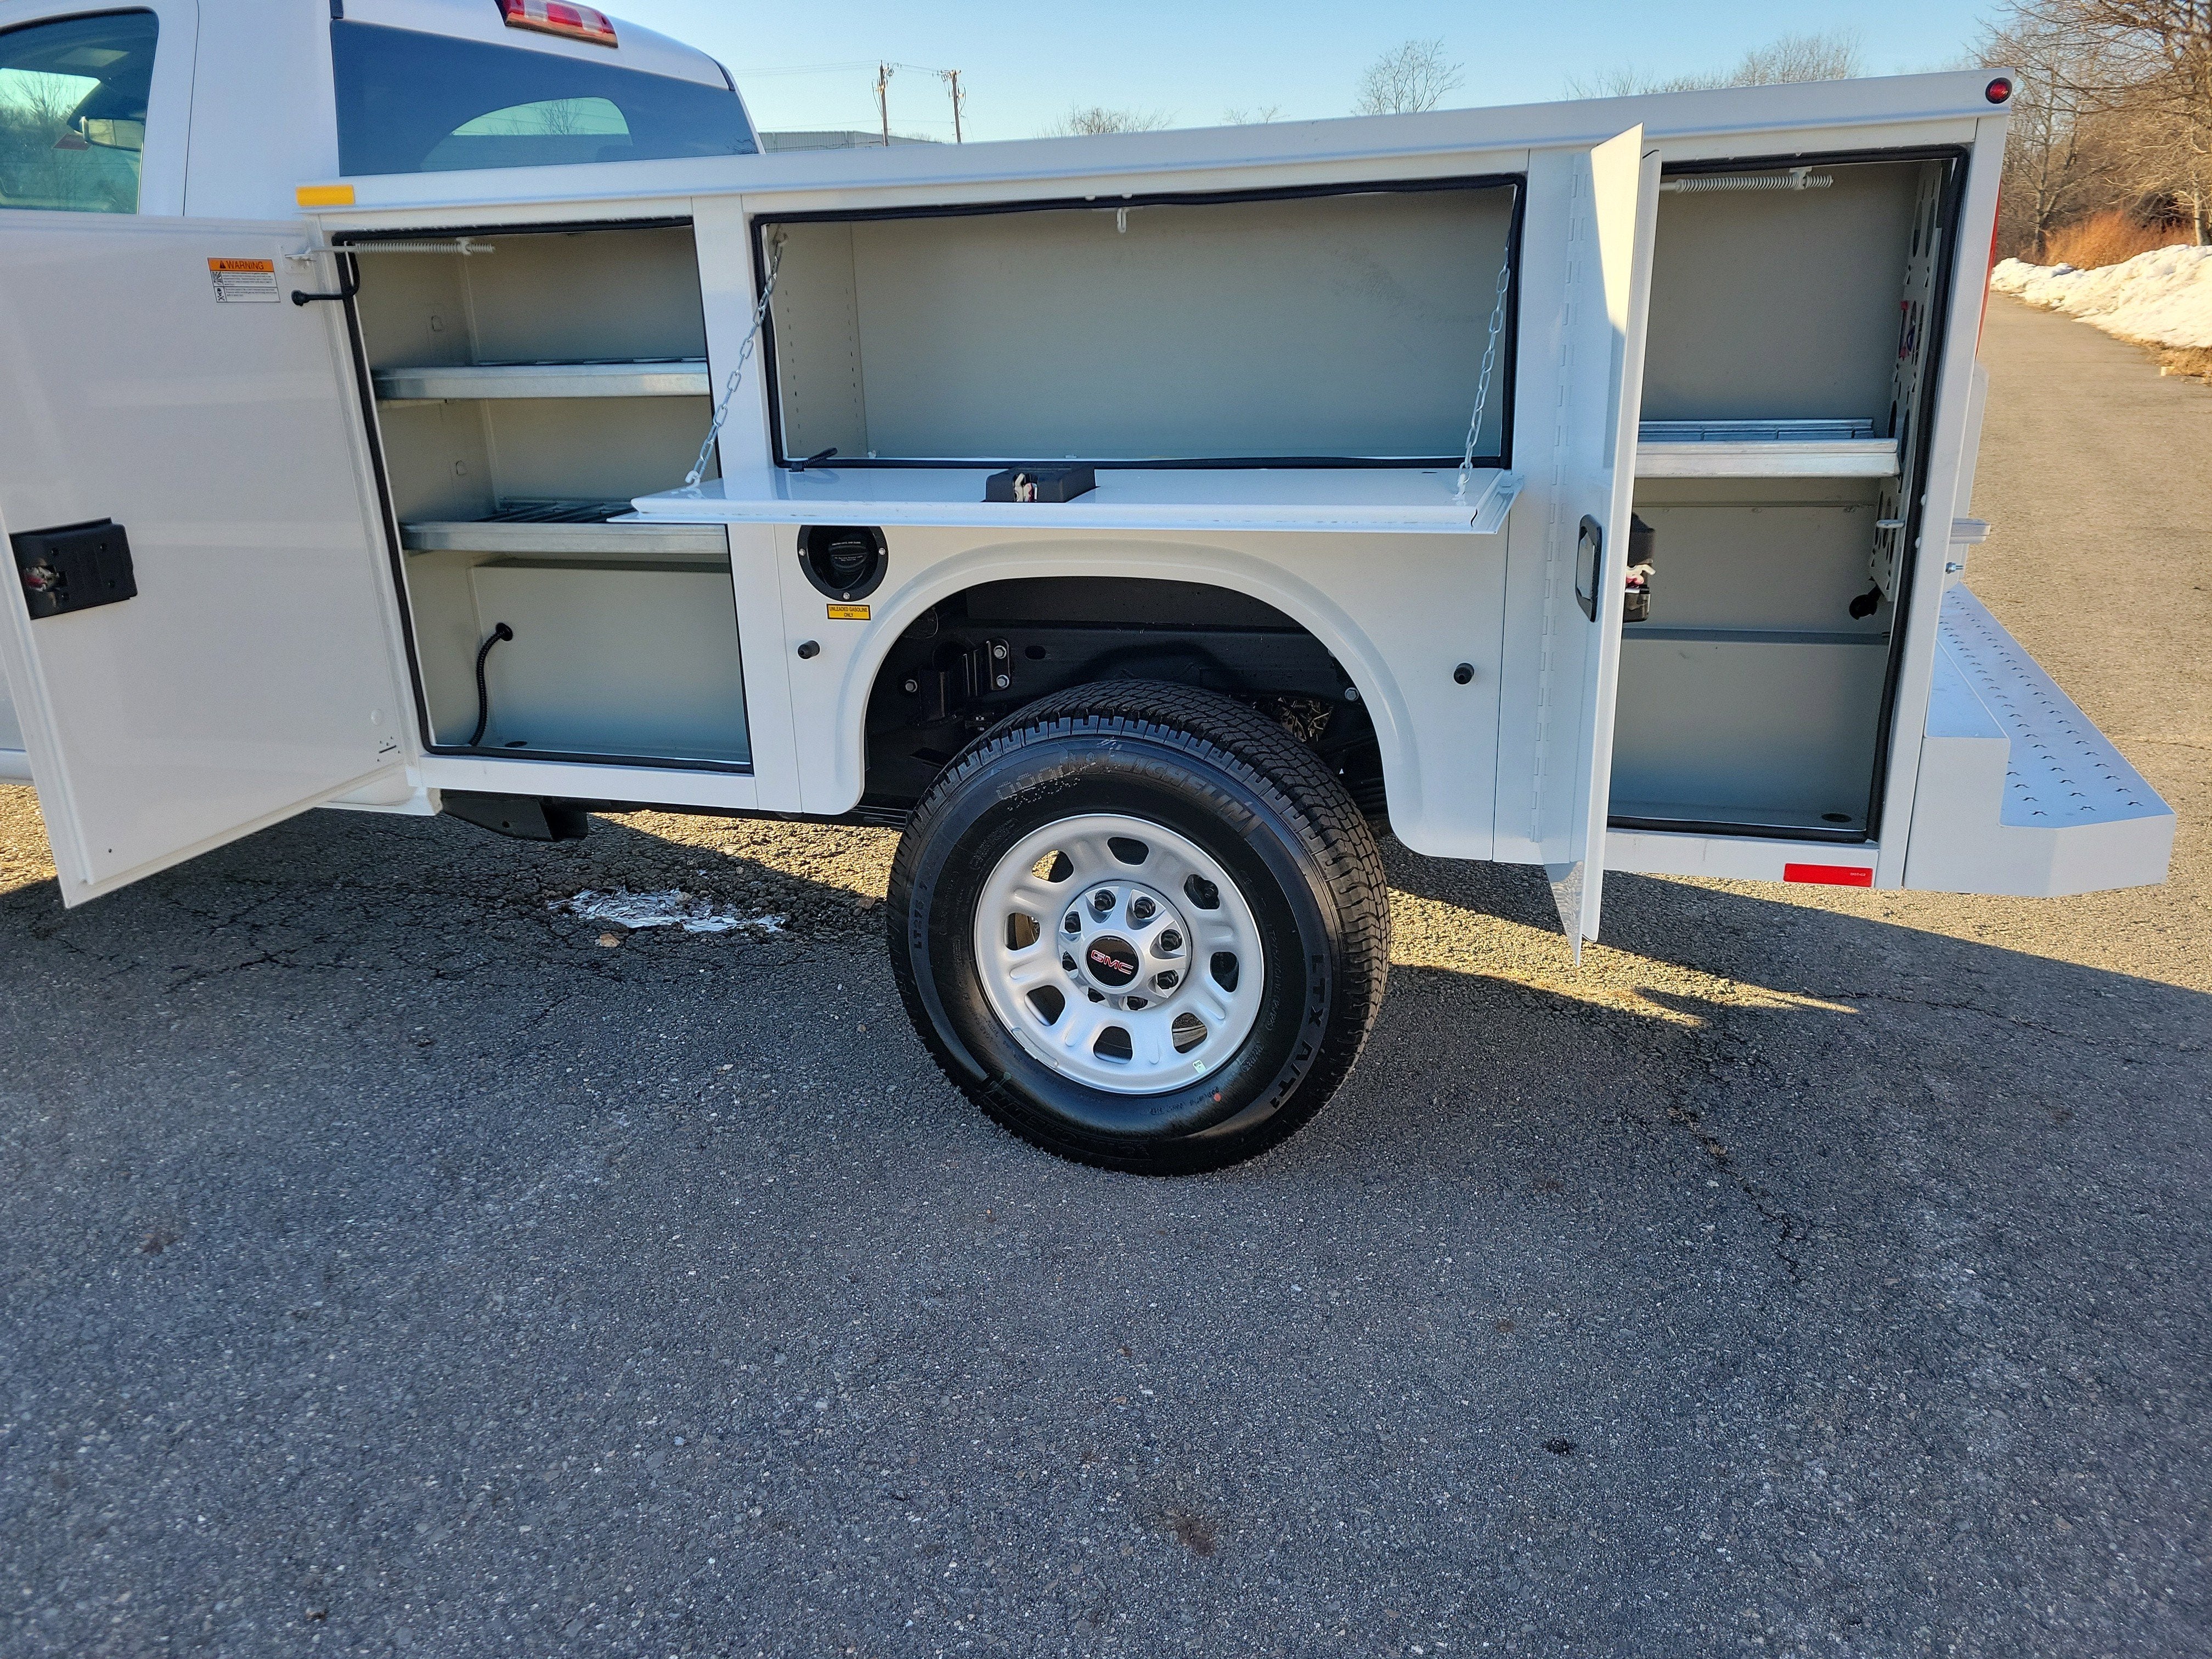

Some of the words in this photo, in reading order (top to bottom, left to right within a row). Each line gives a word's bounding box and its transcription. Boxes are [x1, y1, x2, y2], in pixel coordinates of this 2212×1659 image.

[227, 260, 264, 269] WARNING
[1108, 752, 1255, 831] MICHELIN
[1091, 950, 1134, 975] GMC
